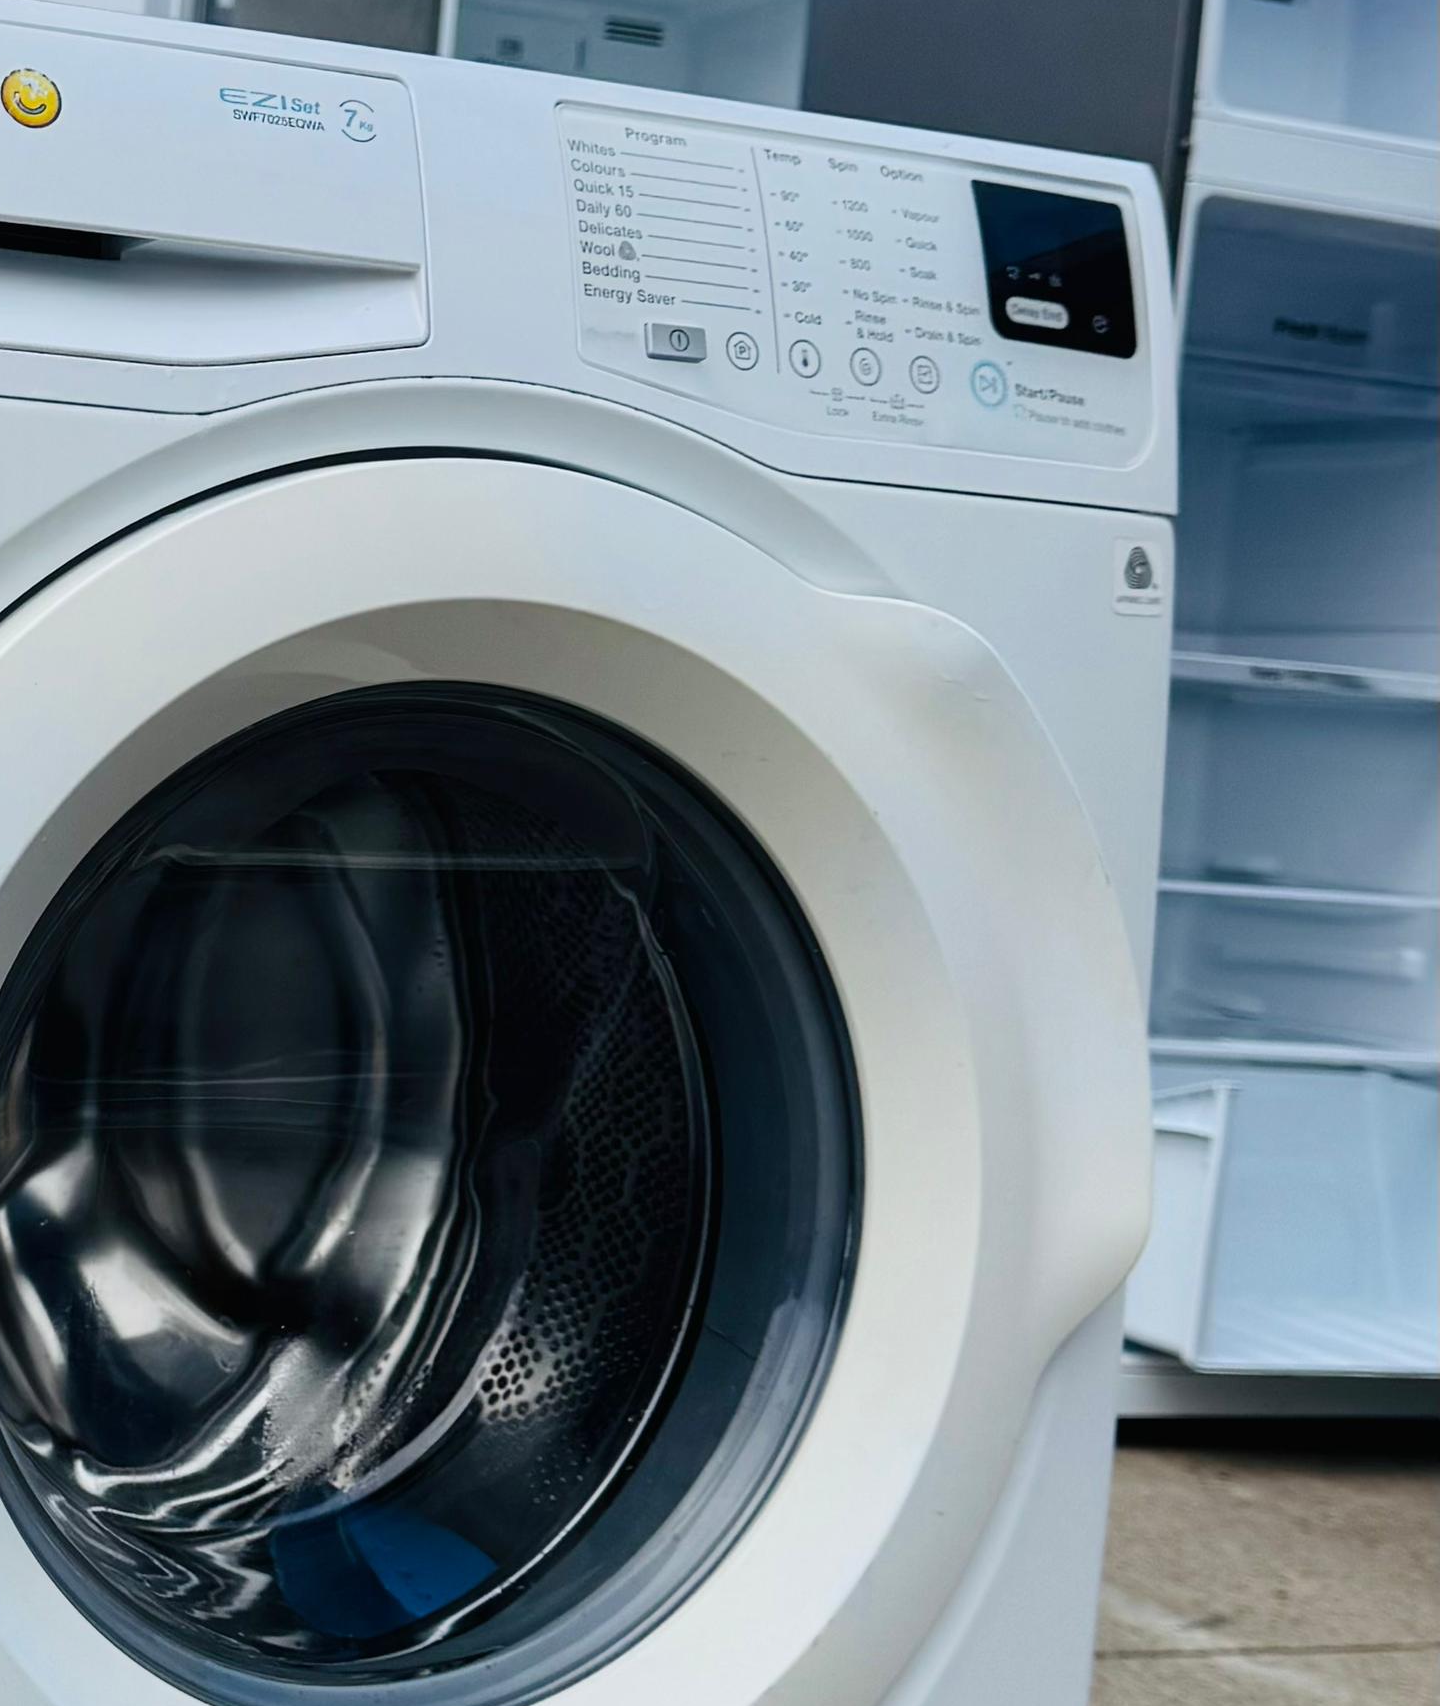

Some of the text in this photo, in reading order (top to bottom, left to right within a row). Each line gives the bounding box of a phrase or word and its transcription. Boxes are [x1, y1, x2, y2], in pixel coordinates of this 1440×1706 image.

[290, 97, 321, 115] Set
[343, 108, 358, 128] 7
[624, 127, 687, 147] Program
[567, 138, 616, 157] Whites
[570, 158, 626, 178] Colours
[763, 148, 924, 182] Temp Spin Option
[573, 178, 634, 198] Quick 15
[576, 198, 632, 218] Daily 60
[578, 219, 643, 240] Delicates
[580, 240, 616, 257] Wool
[582, 260, 641, 283] Bedding
[583, 283, 676, 307] Energy Saver
[794, 310, 823, 326] Cold
